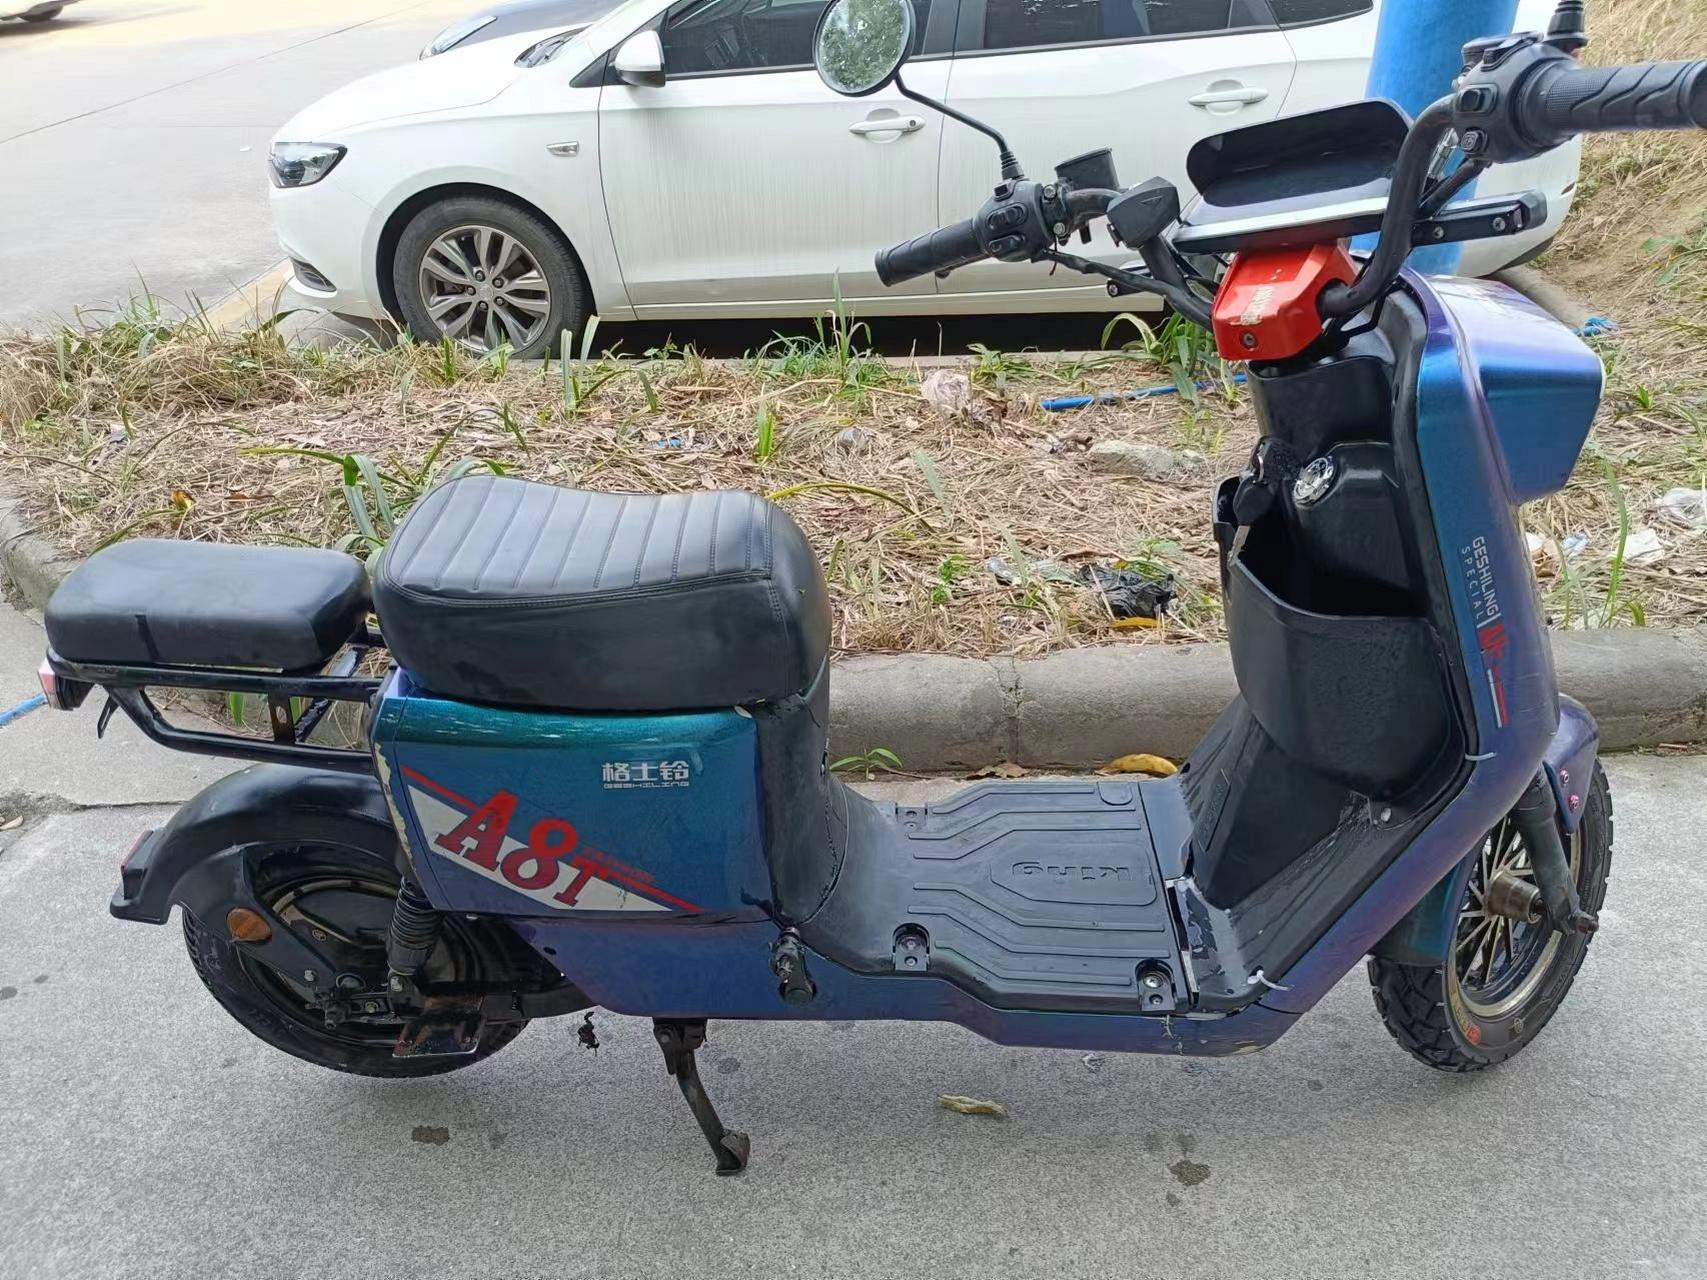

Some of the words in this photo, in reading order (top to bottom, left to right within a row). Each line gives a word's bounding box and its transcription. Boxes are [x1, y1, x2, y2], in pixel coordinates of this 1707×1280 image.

[1461, 546, 1487, 620] SPECIAL
[1472, 536, 1500, 616] GESHILING
[601, 760, 689, 782] 格士铃
